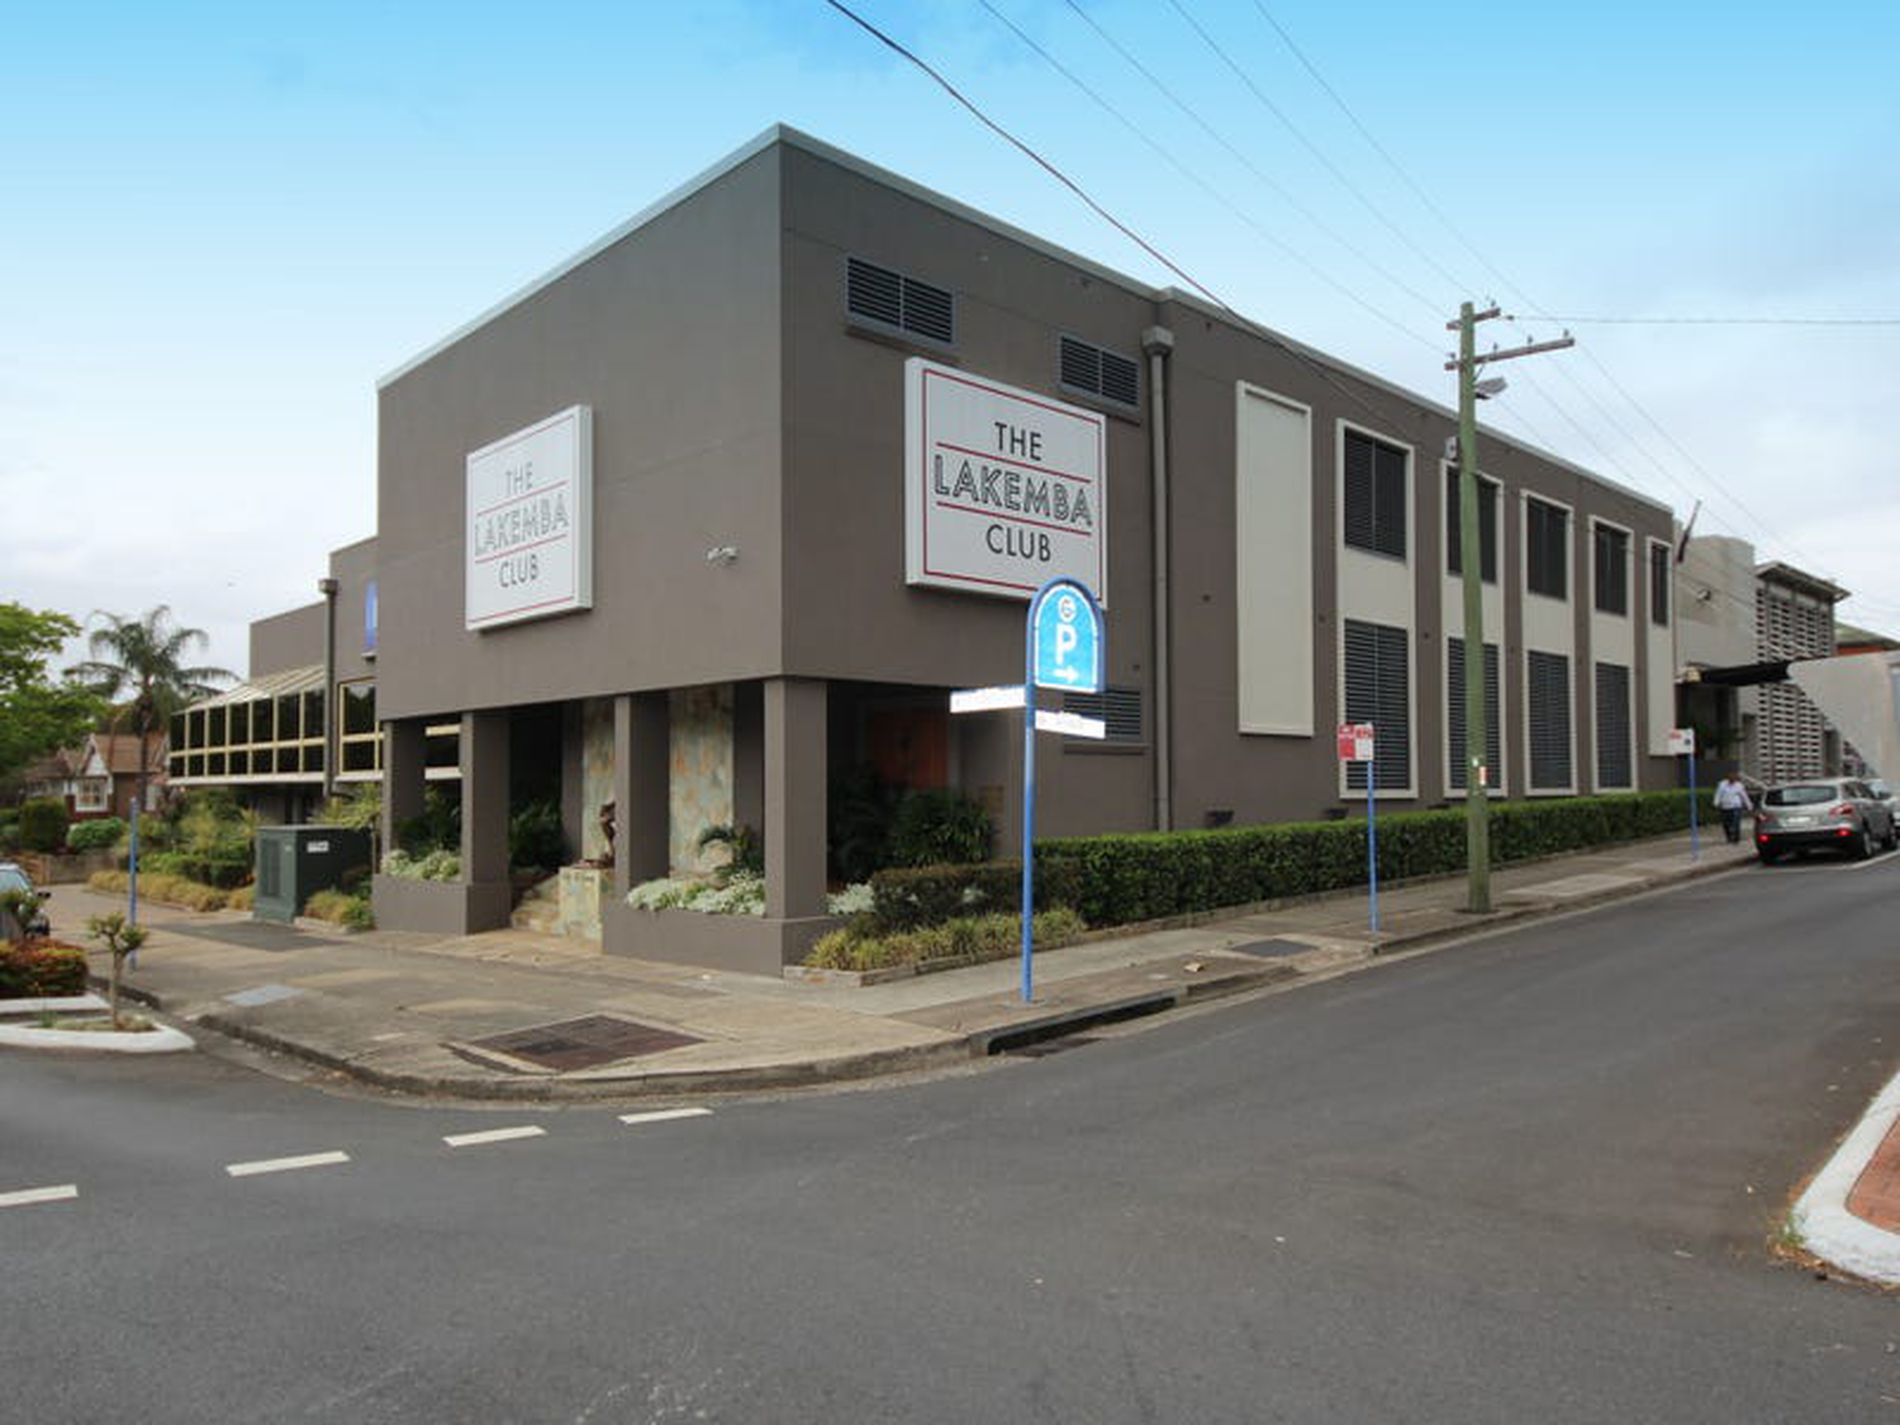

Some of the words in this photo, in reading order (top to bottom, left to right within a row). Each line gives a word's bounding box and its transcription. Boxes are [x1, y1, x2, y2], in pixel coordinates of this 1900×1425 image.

[994, 421, 1042, 461] THE
[505, 462, 533, 495] THE
[933, 454, 1093, 527] LAKEMBA
[474, 494, 569, 557] LAKEMBA
[986, 524, 1051, 562] CLUB
[499, 554, 539, 588] CLUB
[1055, 623, 1077, 666] P
